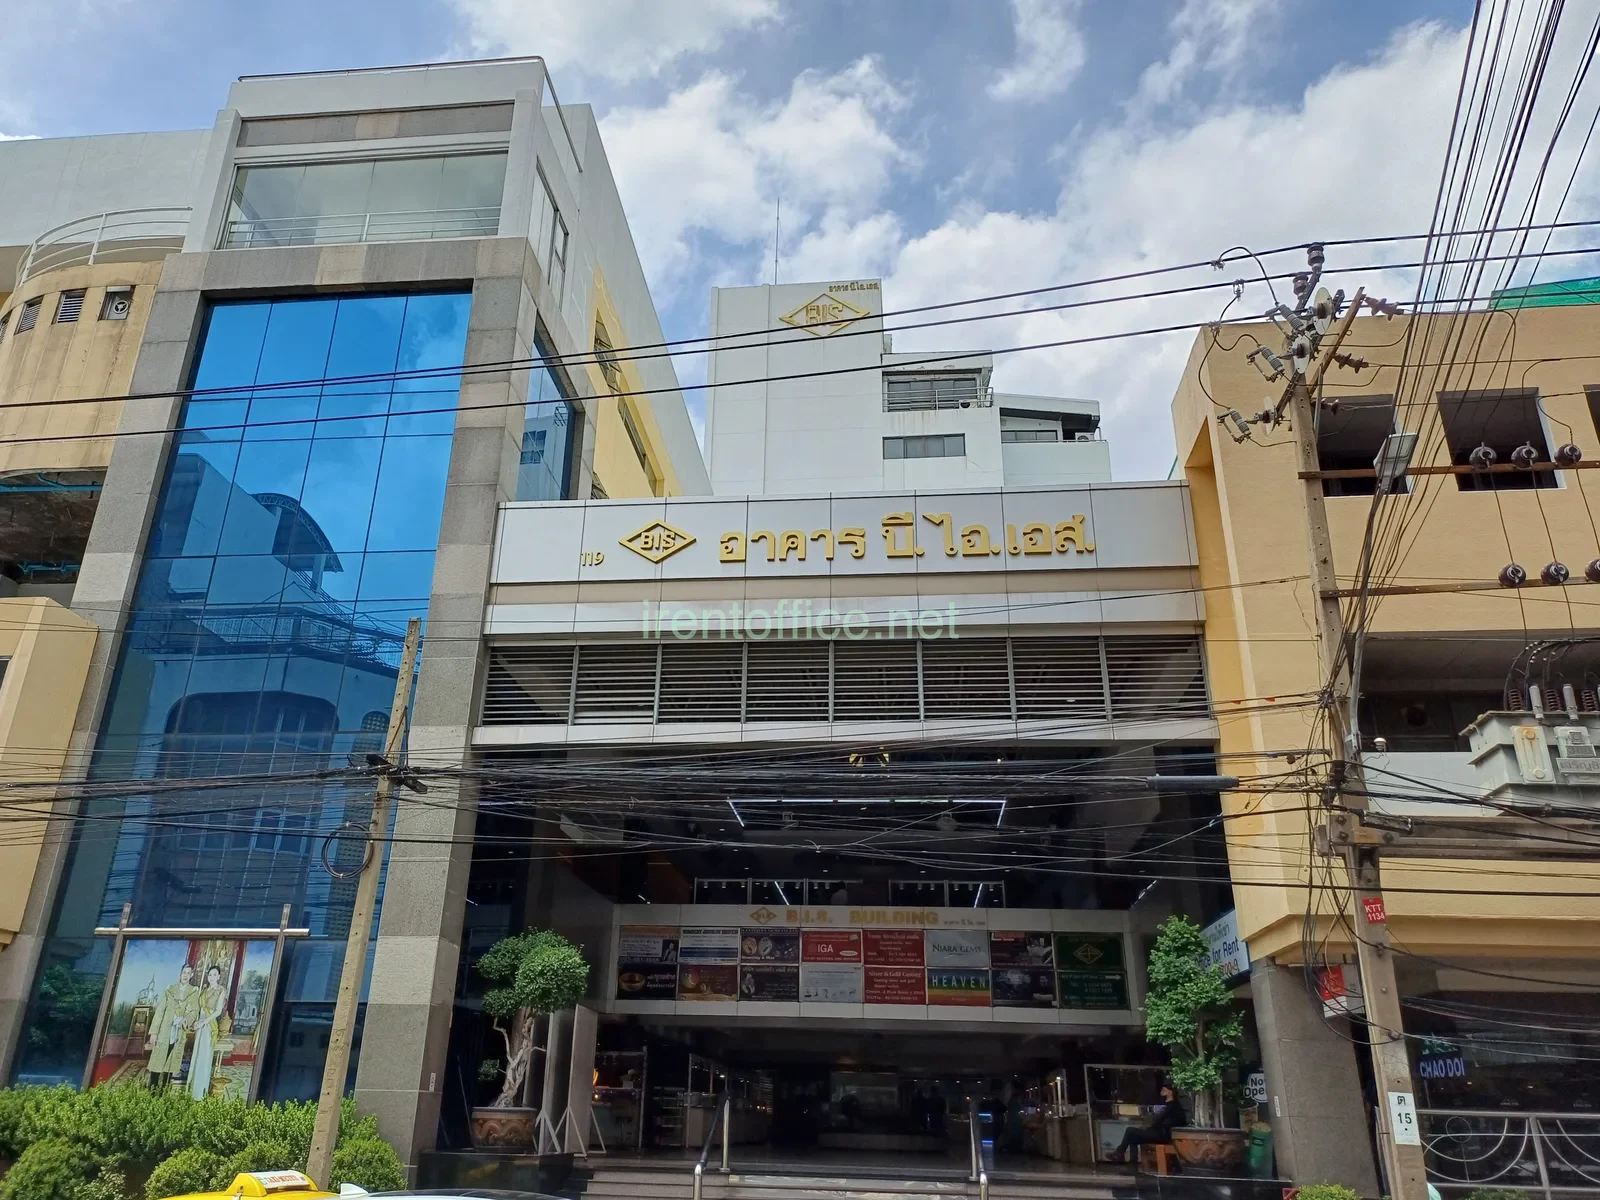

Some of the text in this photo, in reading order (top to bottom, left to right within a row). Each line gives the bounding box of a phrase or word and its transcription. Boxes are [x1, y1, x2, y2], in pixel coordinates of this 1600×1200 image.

[806, 304, 844, 327] BIS
[639, 530, 677, 551] BIS
[719, 527, 866, 563] อาคาร
[581, 551, 605, 566] 119
[1364, 904, 1381, 913] KTT
[851, 910, 939, 925] BUILDING
[1368, 912, 1385, 921] 1134
[817, 944, 834, 953] IGA
[1222, 936, 1239, 958] Rent
[932, 974, 986, 988] HEAVEN
[1420, 1057, 1465, 1078] CHAO DOI
[1250, 1077, 1264, 1087] No
[1244, 1087, 1265, 1098] Ope
[1397, 1112, 1412, 1124] 15
